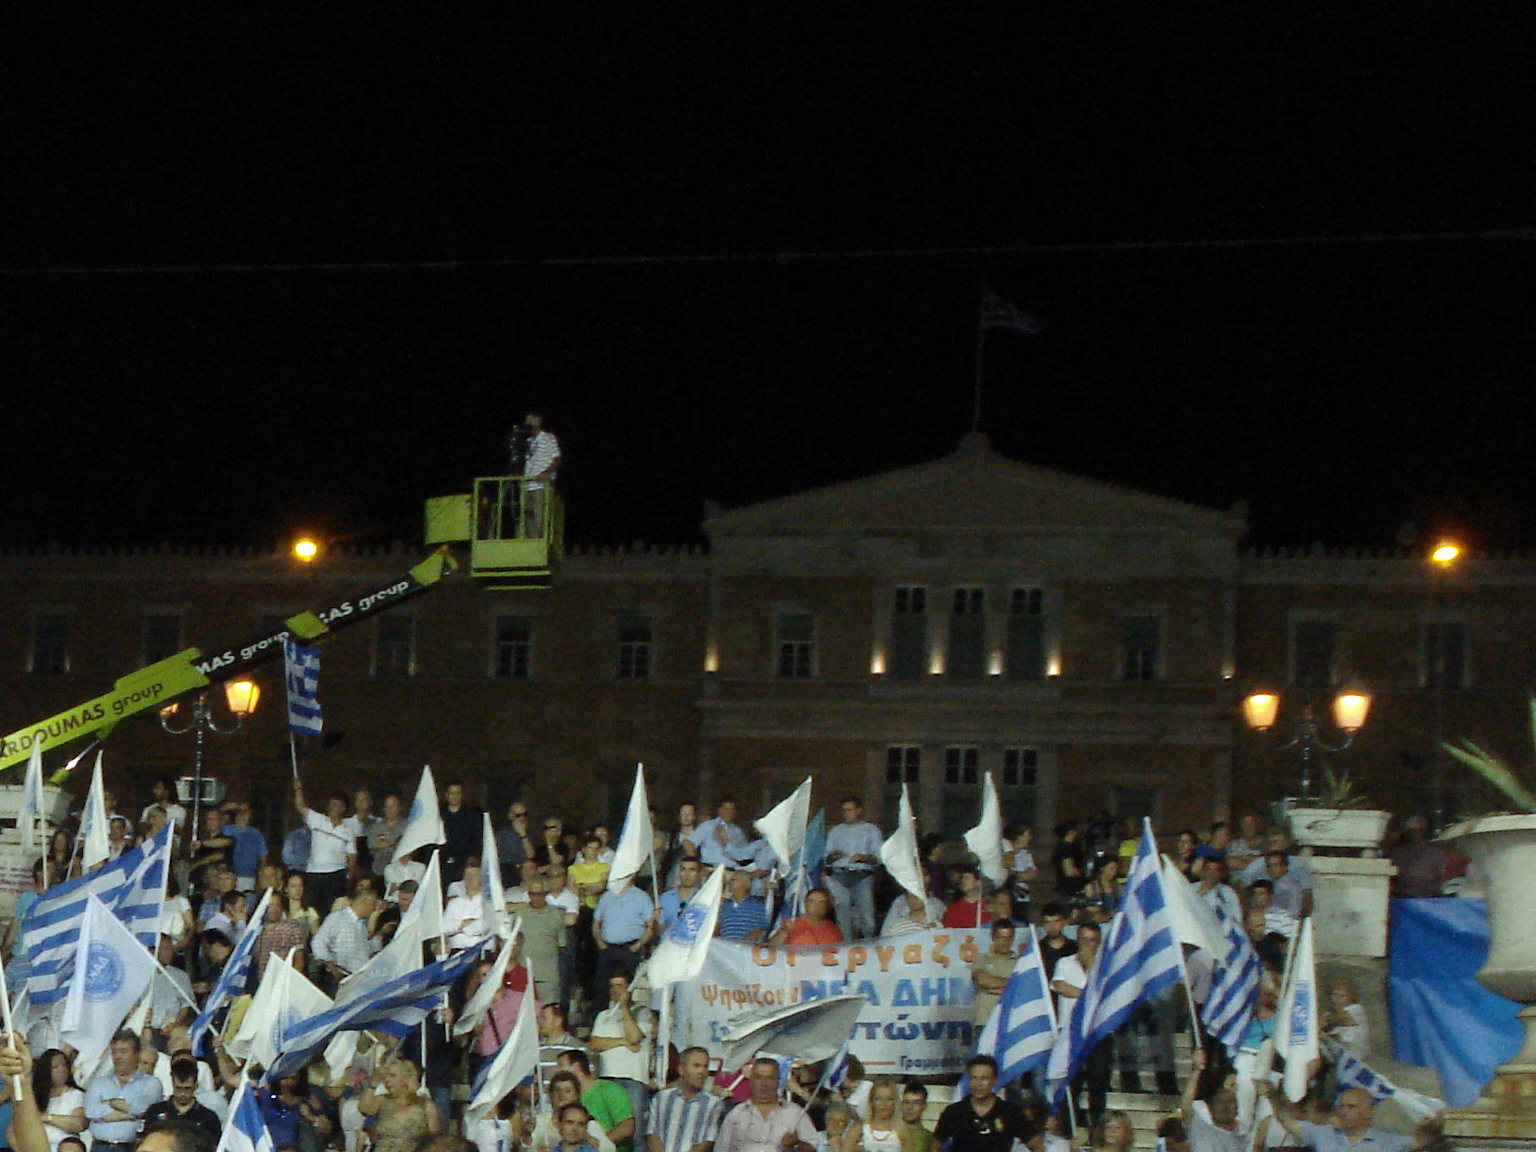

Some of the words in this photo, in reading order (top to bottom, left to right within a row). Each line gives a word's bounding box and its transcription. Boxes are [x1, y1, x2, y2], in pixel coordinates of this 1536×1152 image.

[359, 580, 409, 610] group
[113, 683, 163, 715] group
[821, 934, 979, 973] εργαζό
